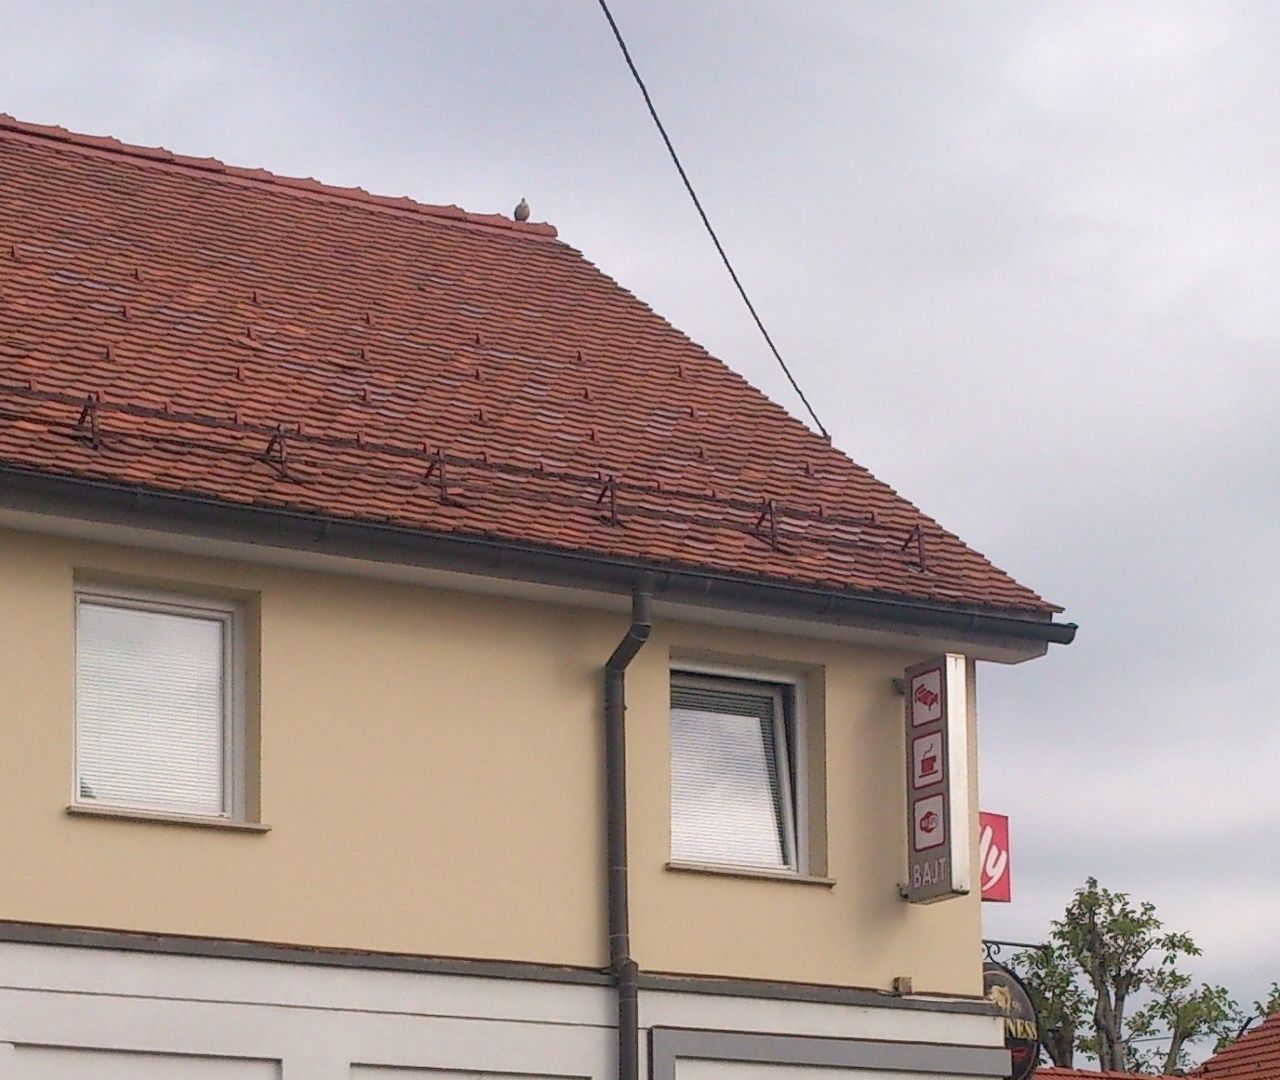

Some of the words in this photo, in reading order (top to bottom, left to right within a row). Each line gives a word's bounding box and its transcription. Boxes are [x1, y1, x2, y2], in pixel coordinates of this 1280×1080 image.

[979, 824, 1008, 891] ly
[912, 858, 947, 889] BAJT
[1005, 1017, 1038, 1041] NESS
